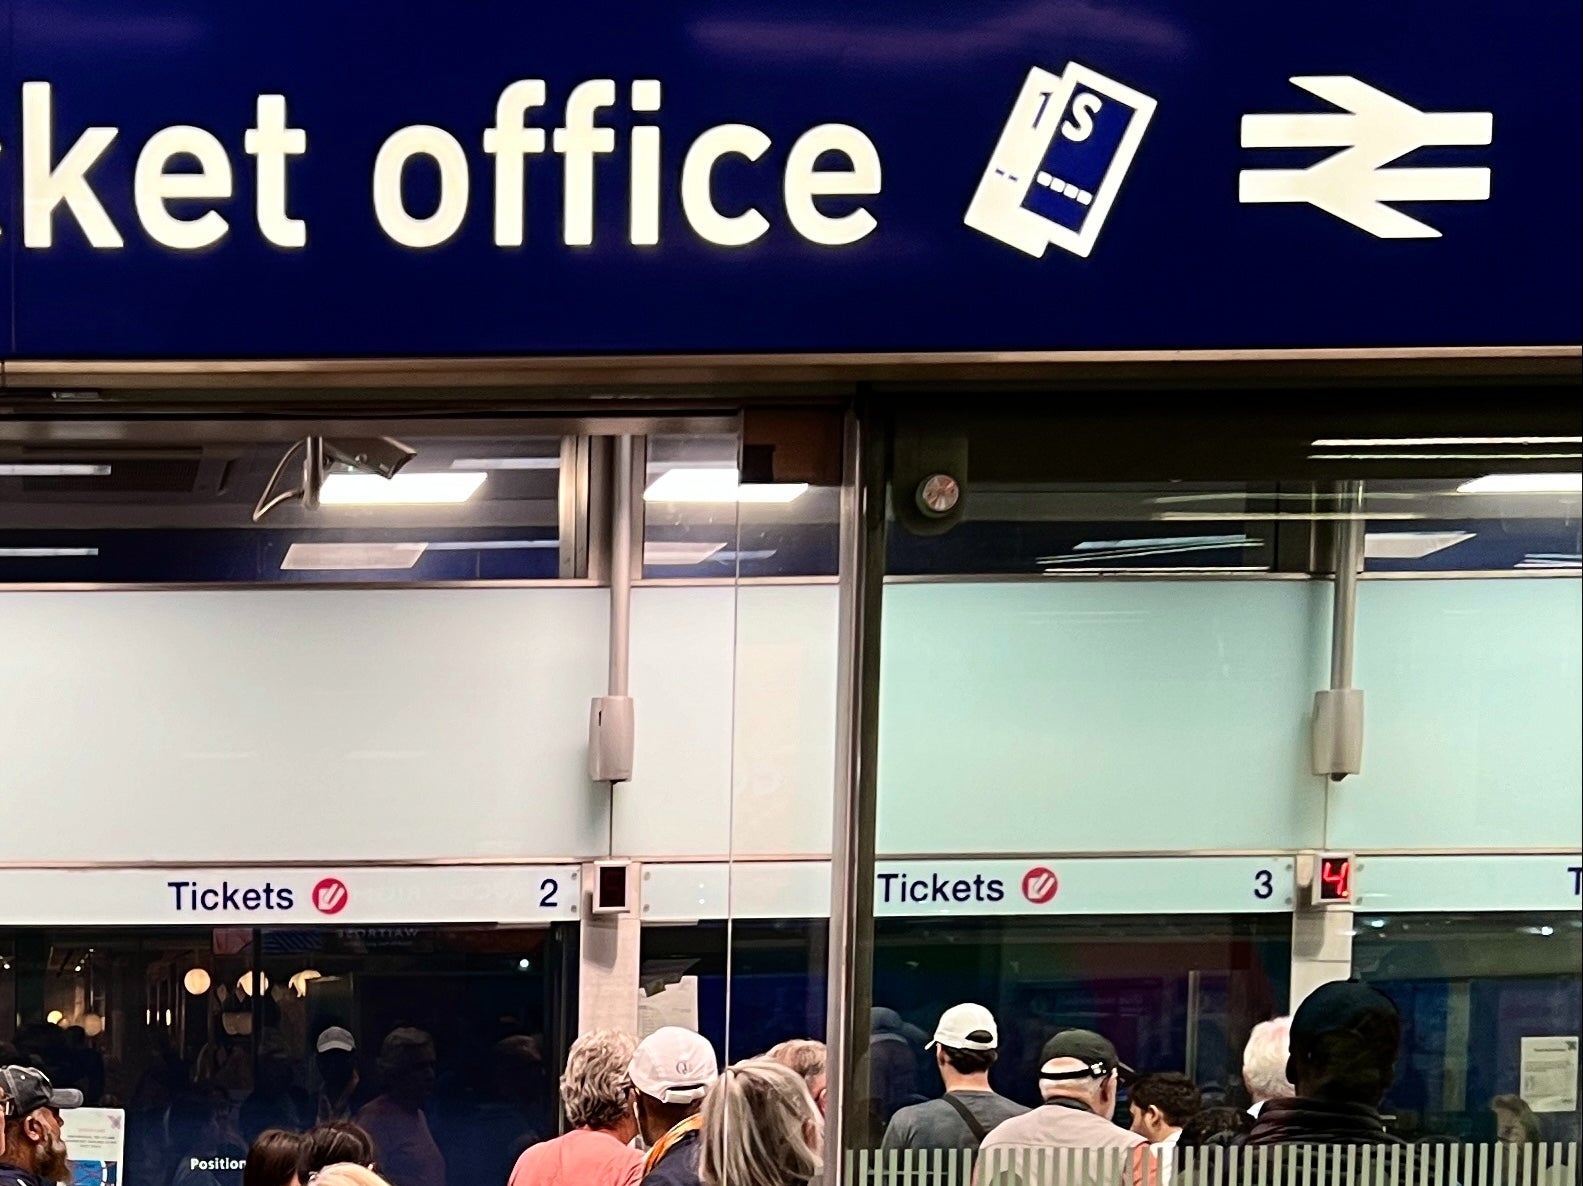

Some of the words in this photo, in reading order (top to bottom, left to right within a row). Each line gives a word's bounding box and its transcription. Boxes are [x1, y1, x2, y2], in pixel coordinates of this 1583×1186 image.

[372, 78, 882, 248] office
[167, 881, 294, 911] Tickets
[539, 878, 558, 908] 2
[877, 872, 1005, 903] Tickets
[1254, 869, 1273, 899] 3
